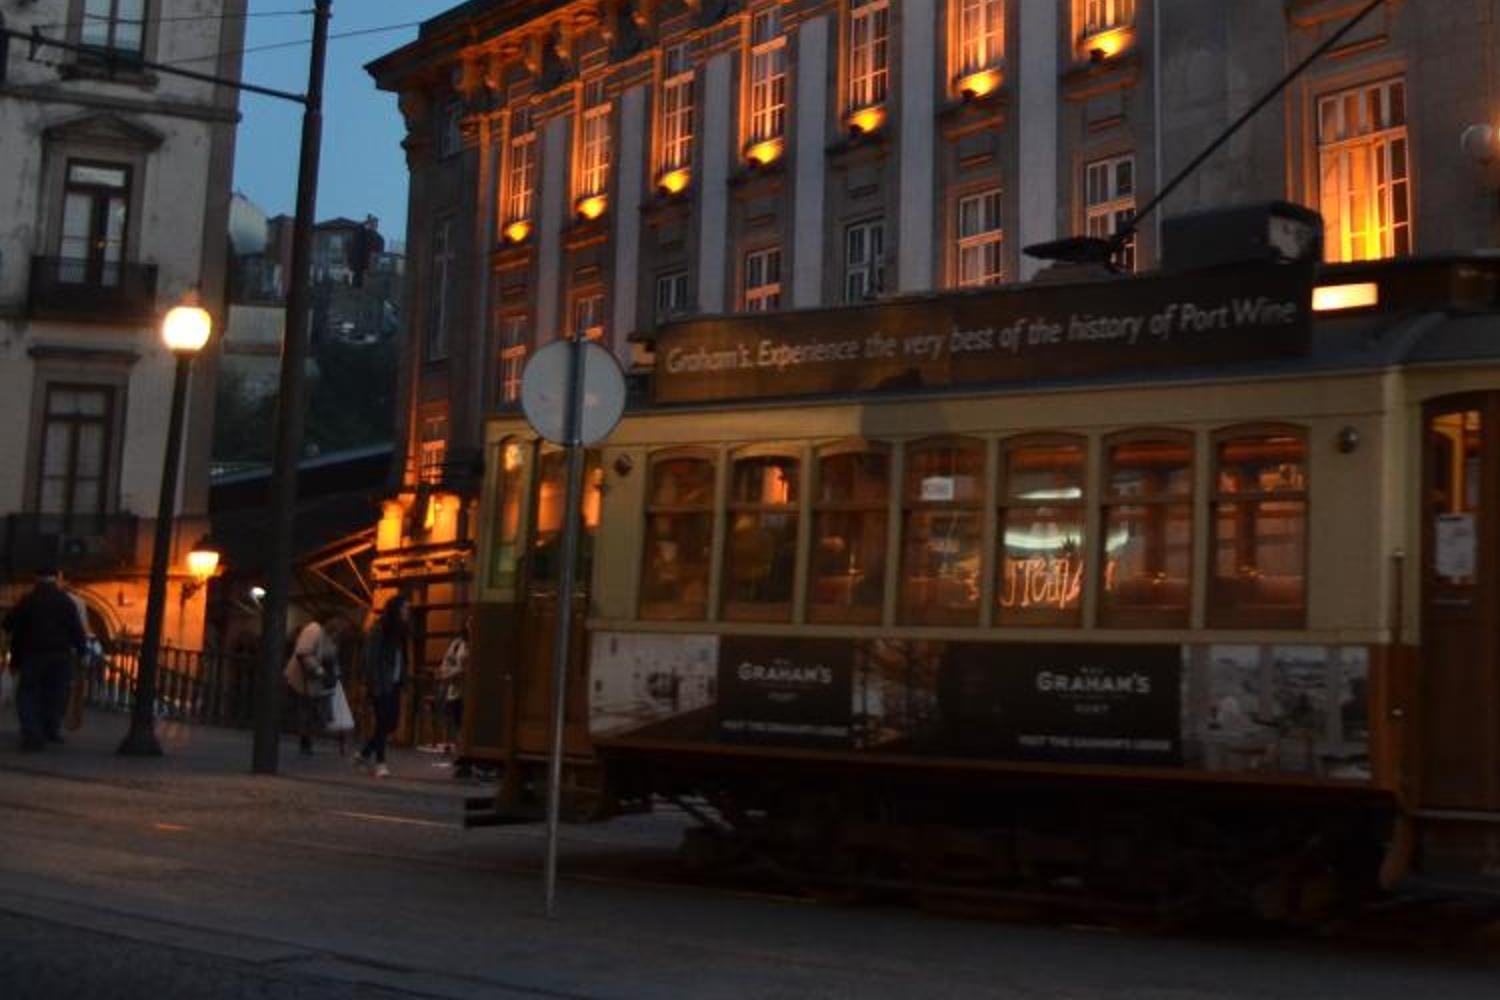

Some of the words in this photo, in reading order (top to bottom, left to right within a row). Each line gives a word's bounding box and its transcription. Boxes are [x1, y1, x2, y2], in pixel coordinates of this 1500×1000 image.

[757, 338, 860, 371] Experience
[863, 331, 897, 359] the
[904, 334, 948, 361] very
[952, 326, 993, 351] best
[999, 317, 1027, 353] of
[1028, 318, 1062, 345] the
[1067, 313, 1145, 344] history
[1150, 302, 1178, 340] of
[1179, 301, 1229, 332] Port
[1231, 296, 1297, 325] Wine
[1036, 670, 1152, 694] GRAHAM'S
